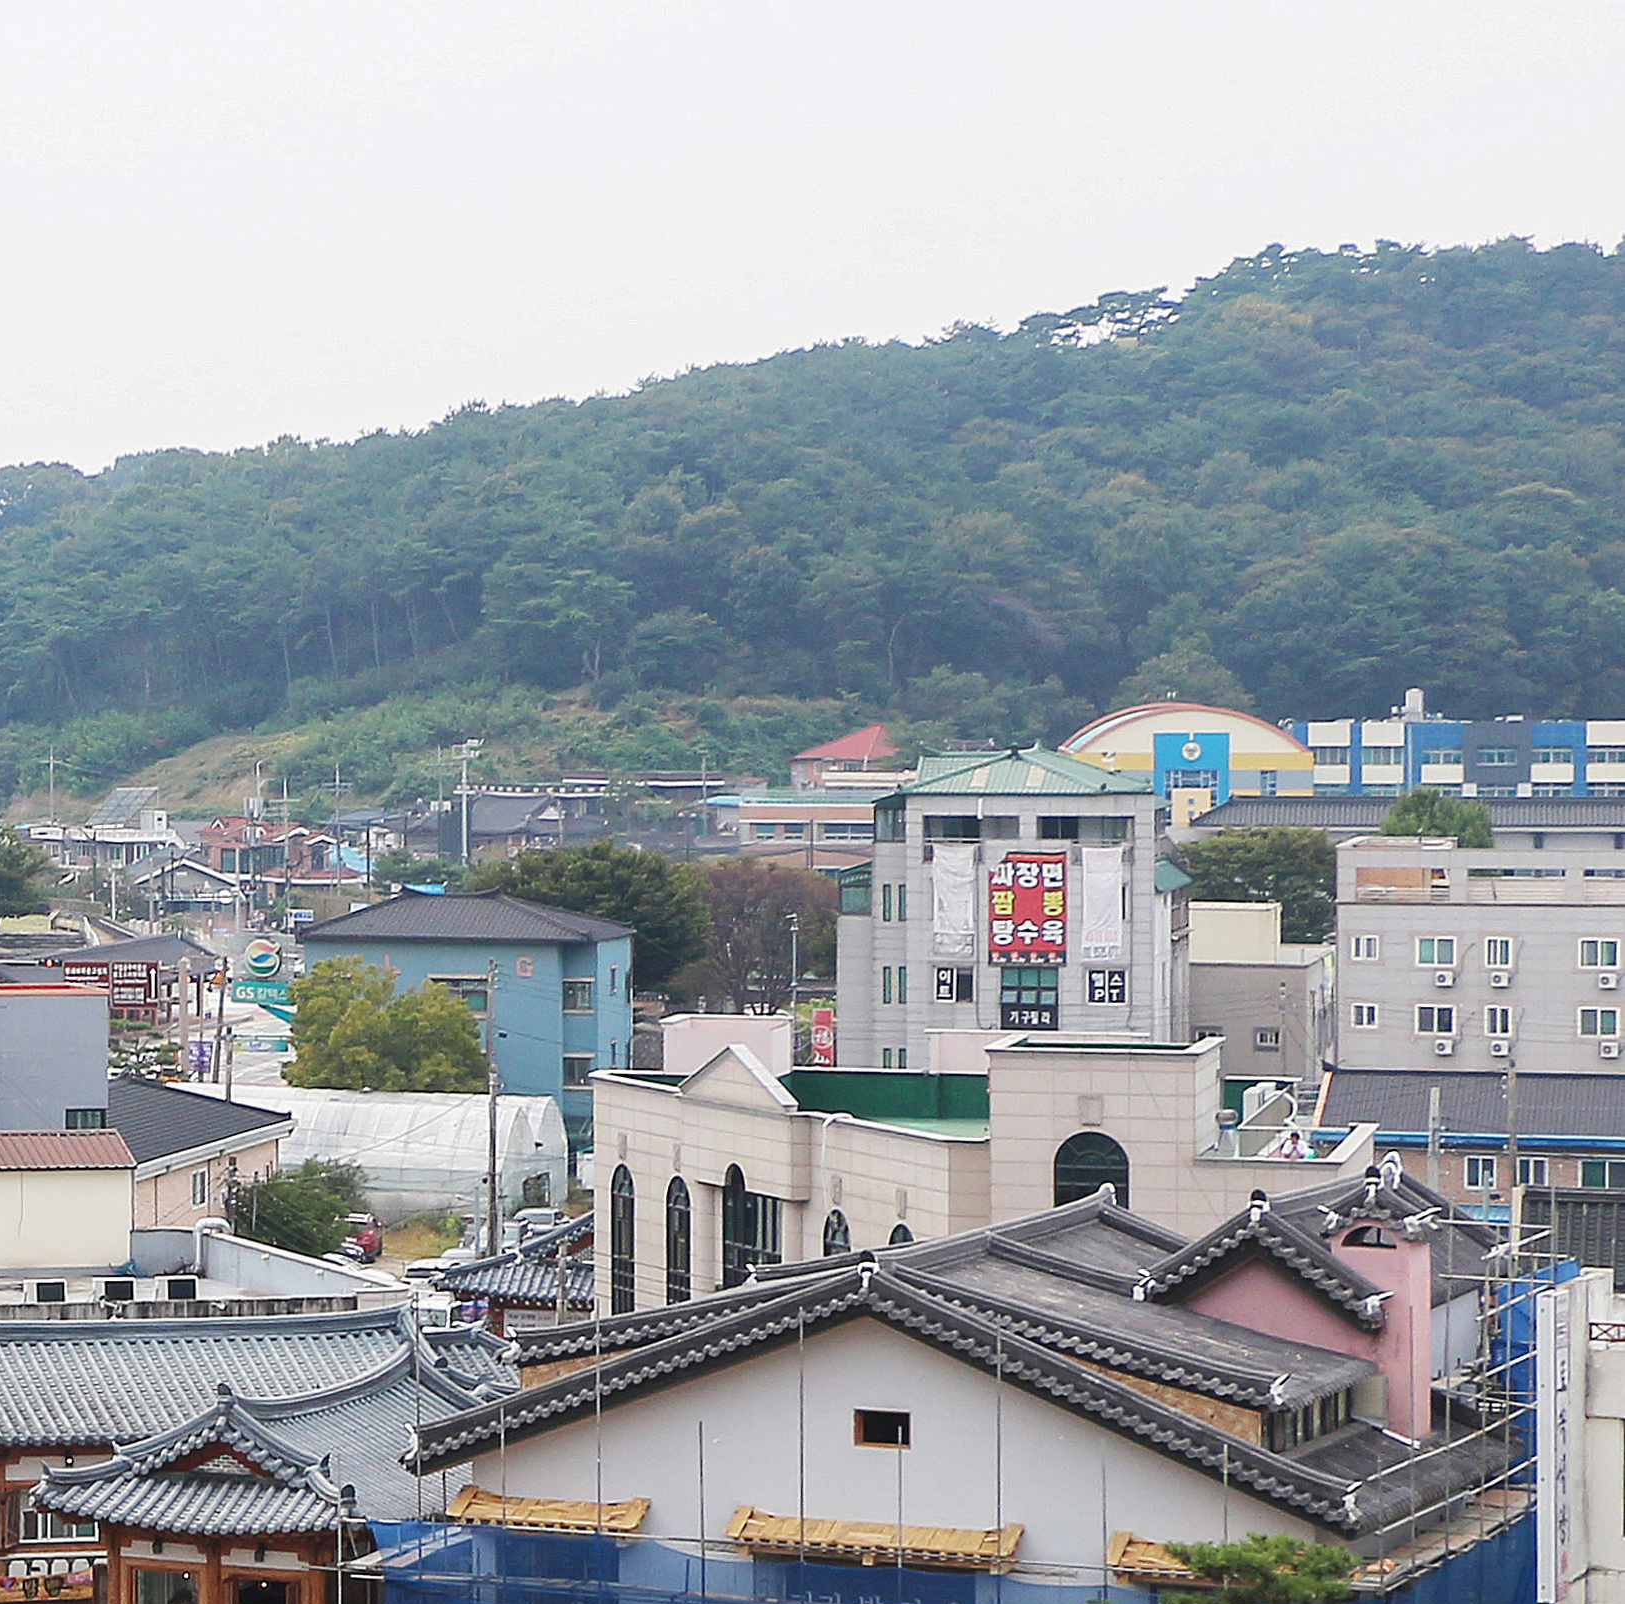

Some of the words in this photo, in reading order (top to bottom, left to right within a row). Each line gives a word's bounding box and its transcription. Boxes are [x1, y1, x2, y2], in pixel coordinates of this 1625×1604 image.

[990, 861, 1064, 888] 짜장면
[990, 919, 1064, 946] 탕수육
[235, 986, 256, 1000] GS
[1093, 989, 1120, 1002] PT
